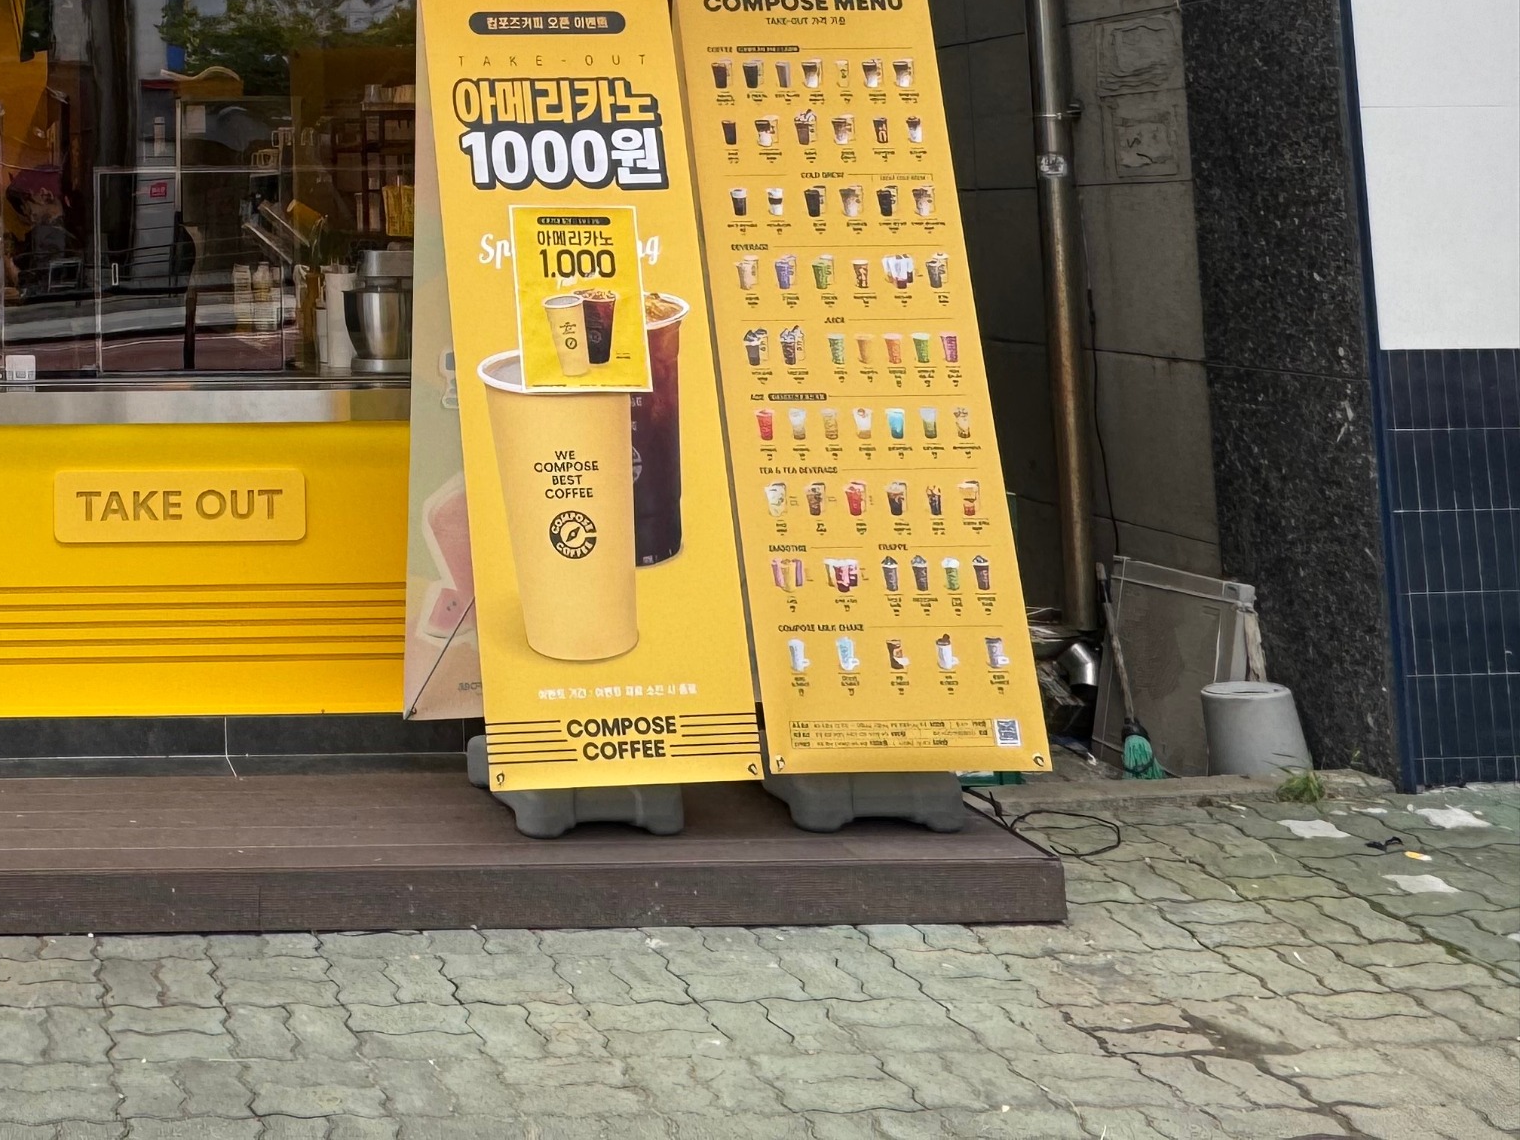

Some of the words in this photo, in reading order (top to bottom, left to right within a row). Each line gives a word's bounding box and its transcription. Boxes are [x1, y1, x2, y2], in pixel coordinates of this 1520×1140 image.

[453, 76, 662, 127] 아메리카노
[460, 126, 664, 186] 1000원
[537, 230, 613, 247] 아메리카노
[539, 248, 616, 278] 1.000
[554, 450, 576, 461] WE
[533, 461, 600, 473] COMPOSE
[552, 474, 583, 486] BEST
[544, 487, 594, 500] COFFEE
[75, 490, 183, 522] TAKE
[195, 489, 284, 520] OUT
[551, 512, 596, 535] COMPOSE
[555, 540, 594, 559] COFFEE
[566, 715, 677, 739] COMPOSE
[582, 739, 667, 761] COFFEE
